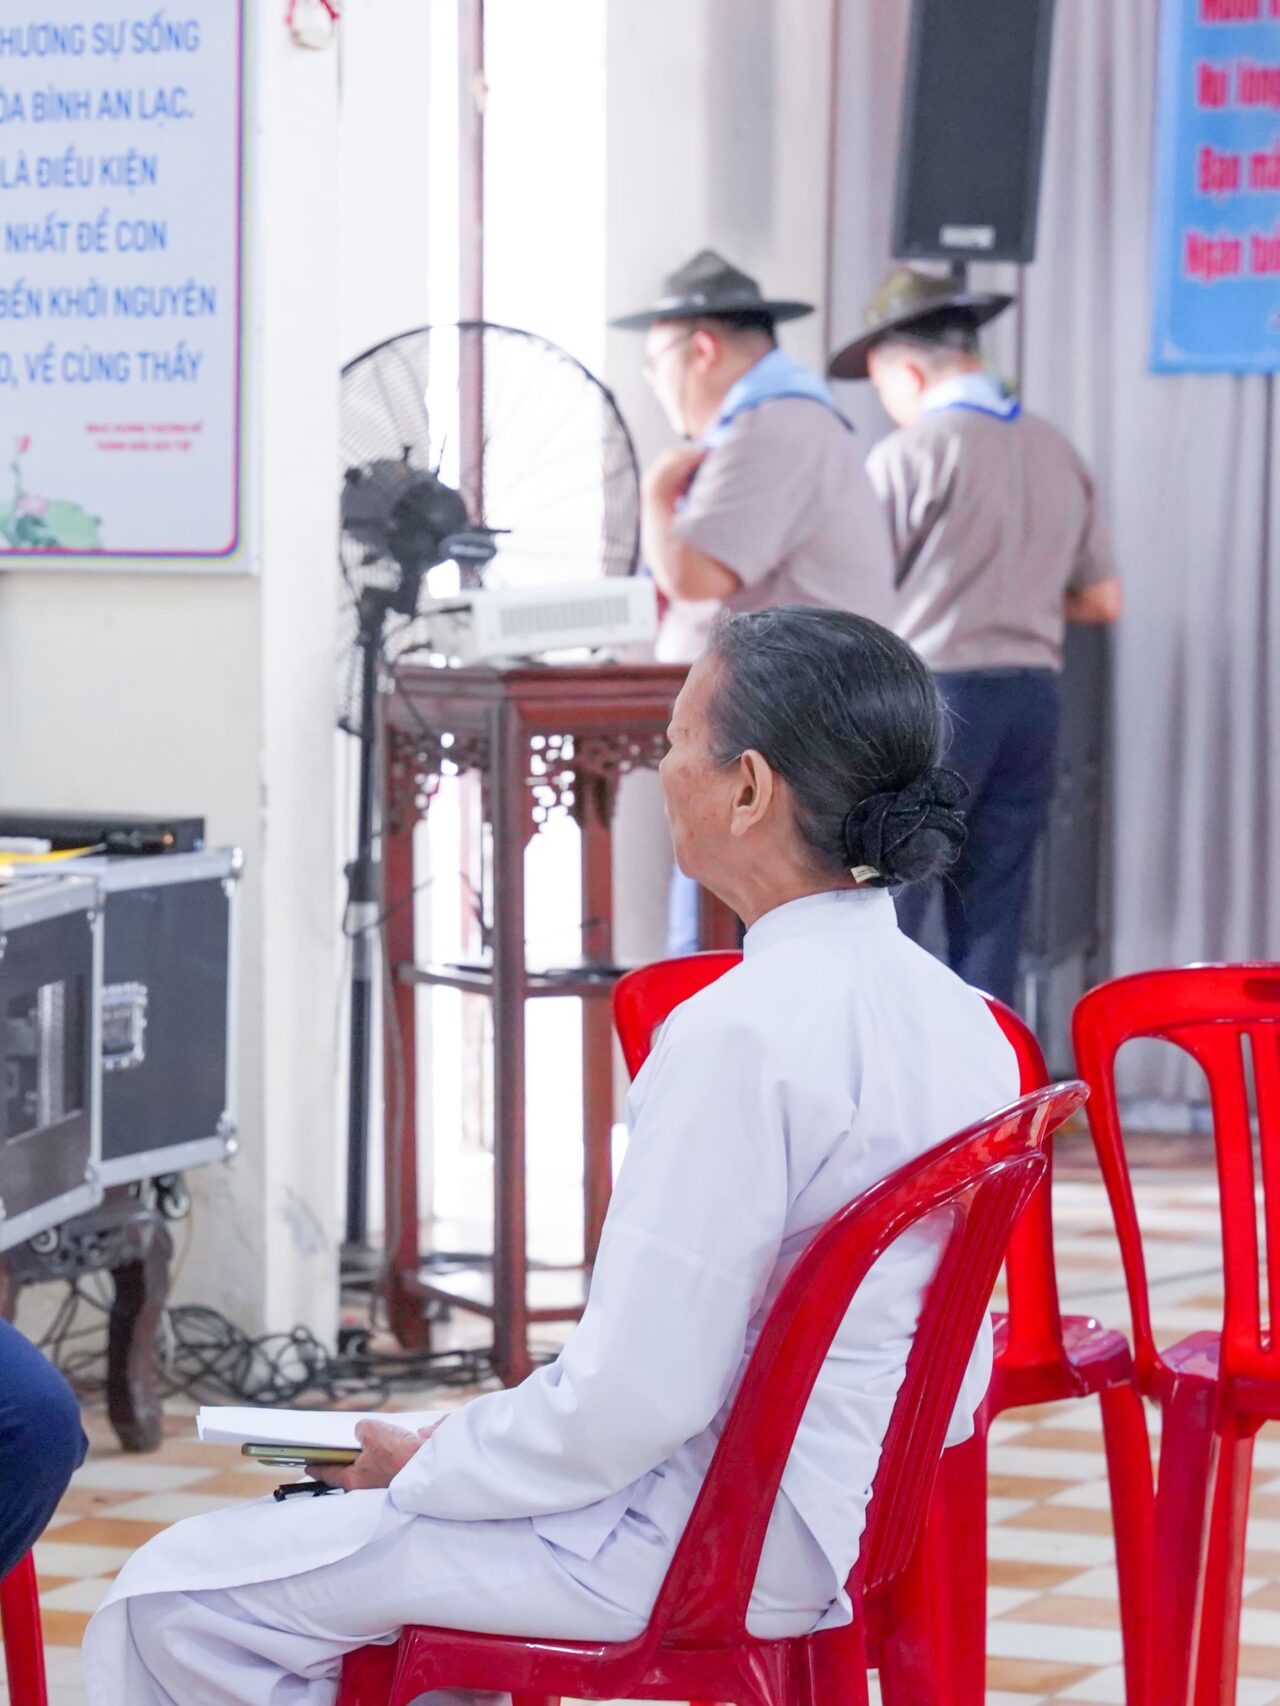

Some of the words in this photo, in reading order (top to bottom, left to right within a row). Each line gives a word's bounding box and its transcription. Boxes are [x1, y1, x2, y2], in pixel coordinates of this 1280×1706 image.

[91, 22, 126, 61] SỰ
[131, 9, 202, 54] SỐNG
[32, 83, 91, 122] BÌNH
[96, 89, 132, 121] AN
[0, 149, 31, 189] LÀ
[100, 146, 158, 194] KIỆN
[5, 209, 71, 254] NHẤT
[115, 220, 169, 253] CON
[48, 277, 108, 318] KHỞI
[114, 277, 217, 317] NGUYÊN
[24, 340, 57, 383] VỀ
[61, 344, 131, 383] CÙNG
[137, 340, 204, 382] THẦY
